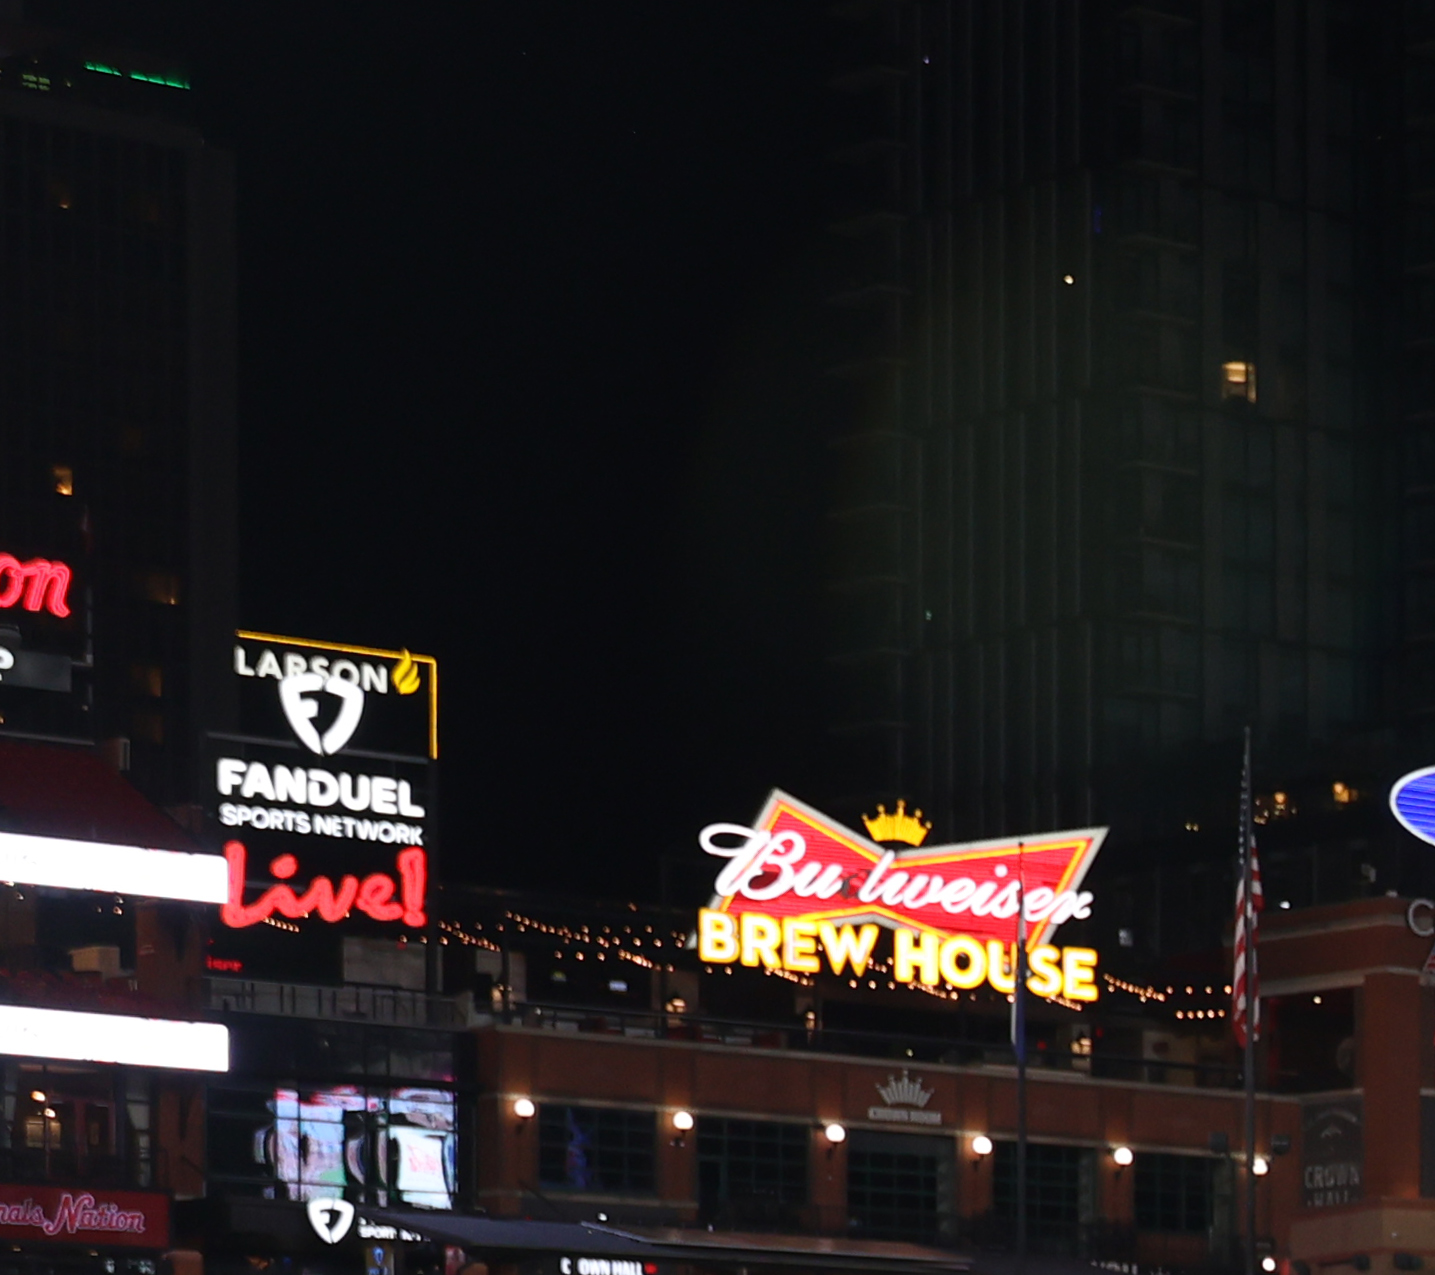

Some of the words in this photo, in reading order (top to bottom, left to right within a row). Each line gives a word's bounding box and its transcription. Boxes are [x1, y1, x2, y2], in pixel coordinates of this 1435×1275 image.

[234, 645, 388, 694] LARSON
[217, 757, 426, 819] FANDUEL
[220, 803, 312, 835] SPORTS
[313, 814, 424, 847] NETWORK
[220, 840, 427, 928] Live!
[699, 823, 1094, 926] Budweiser
[698, 907, 880, 979] BREW
[894, 926, 1099, 1002] HOUSE
[43, 1194, 146, 1236] Nation
